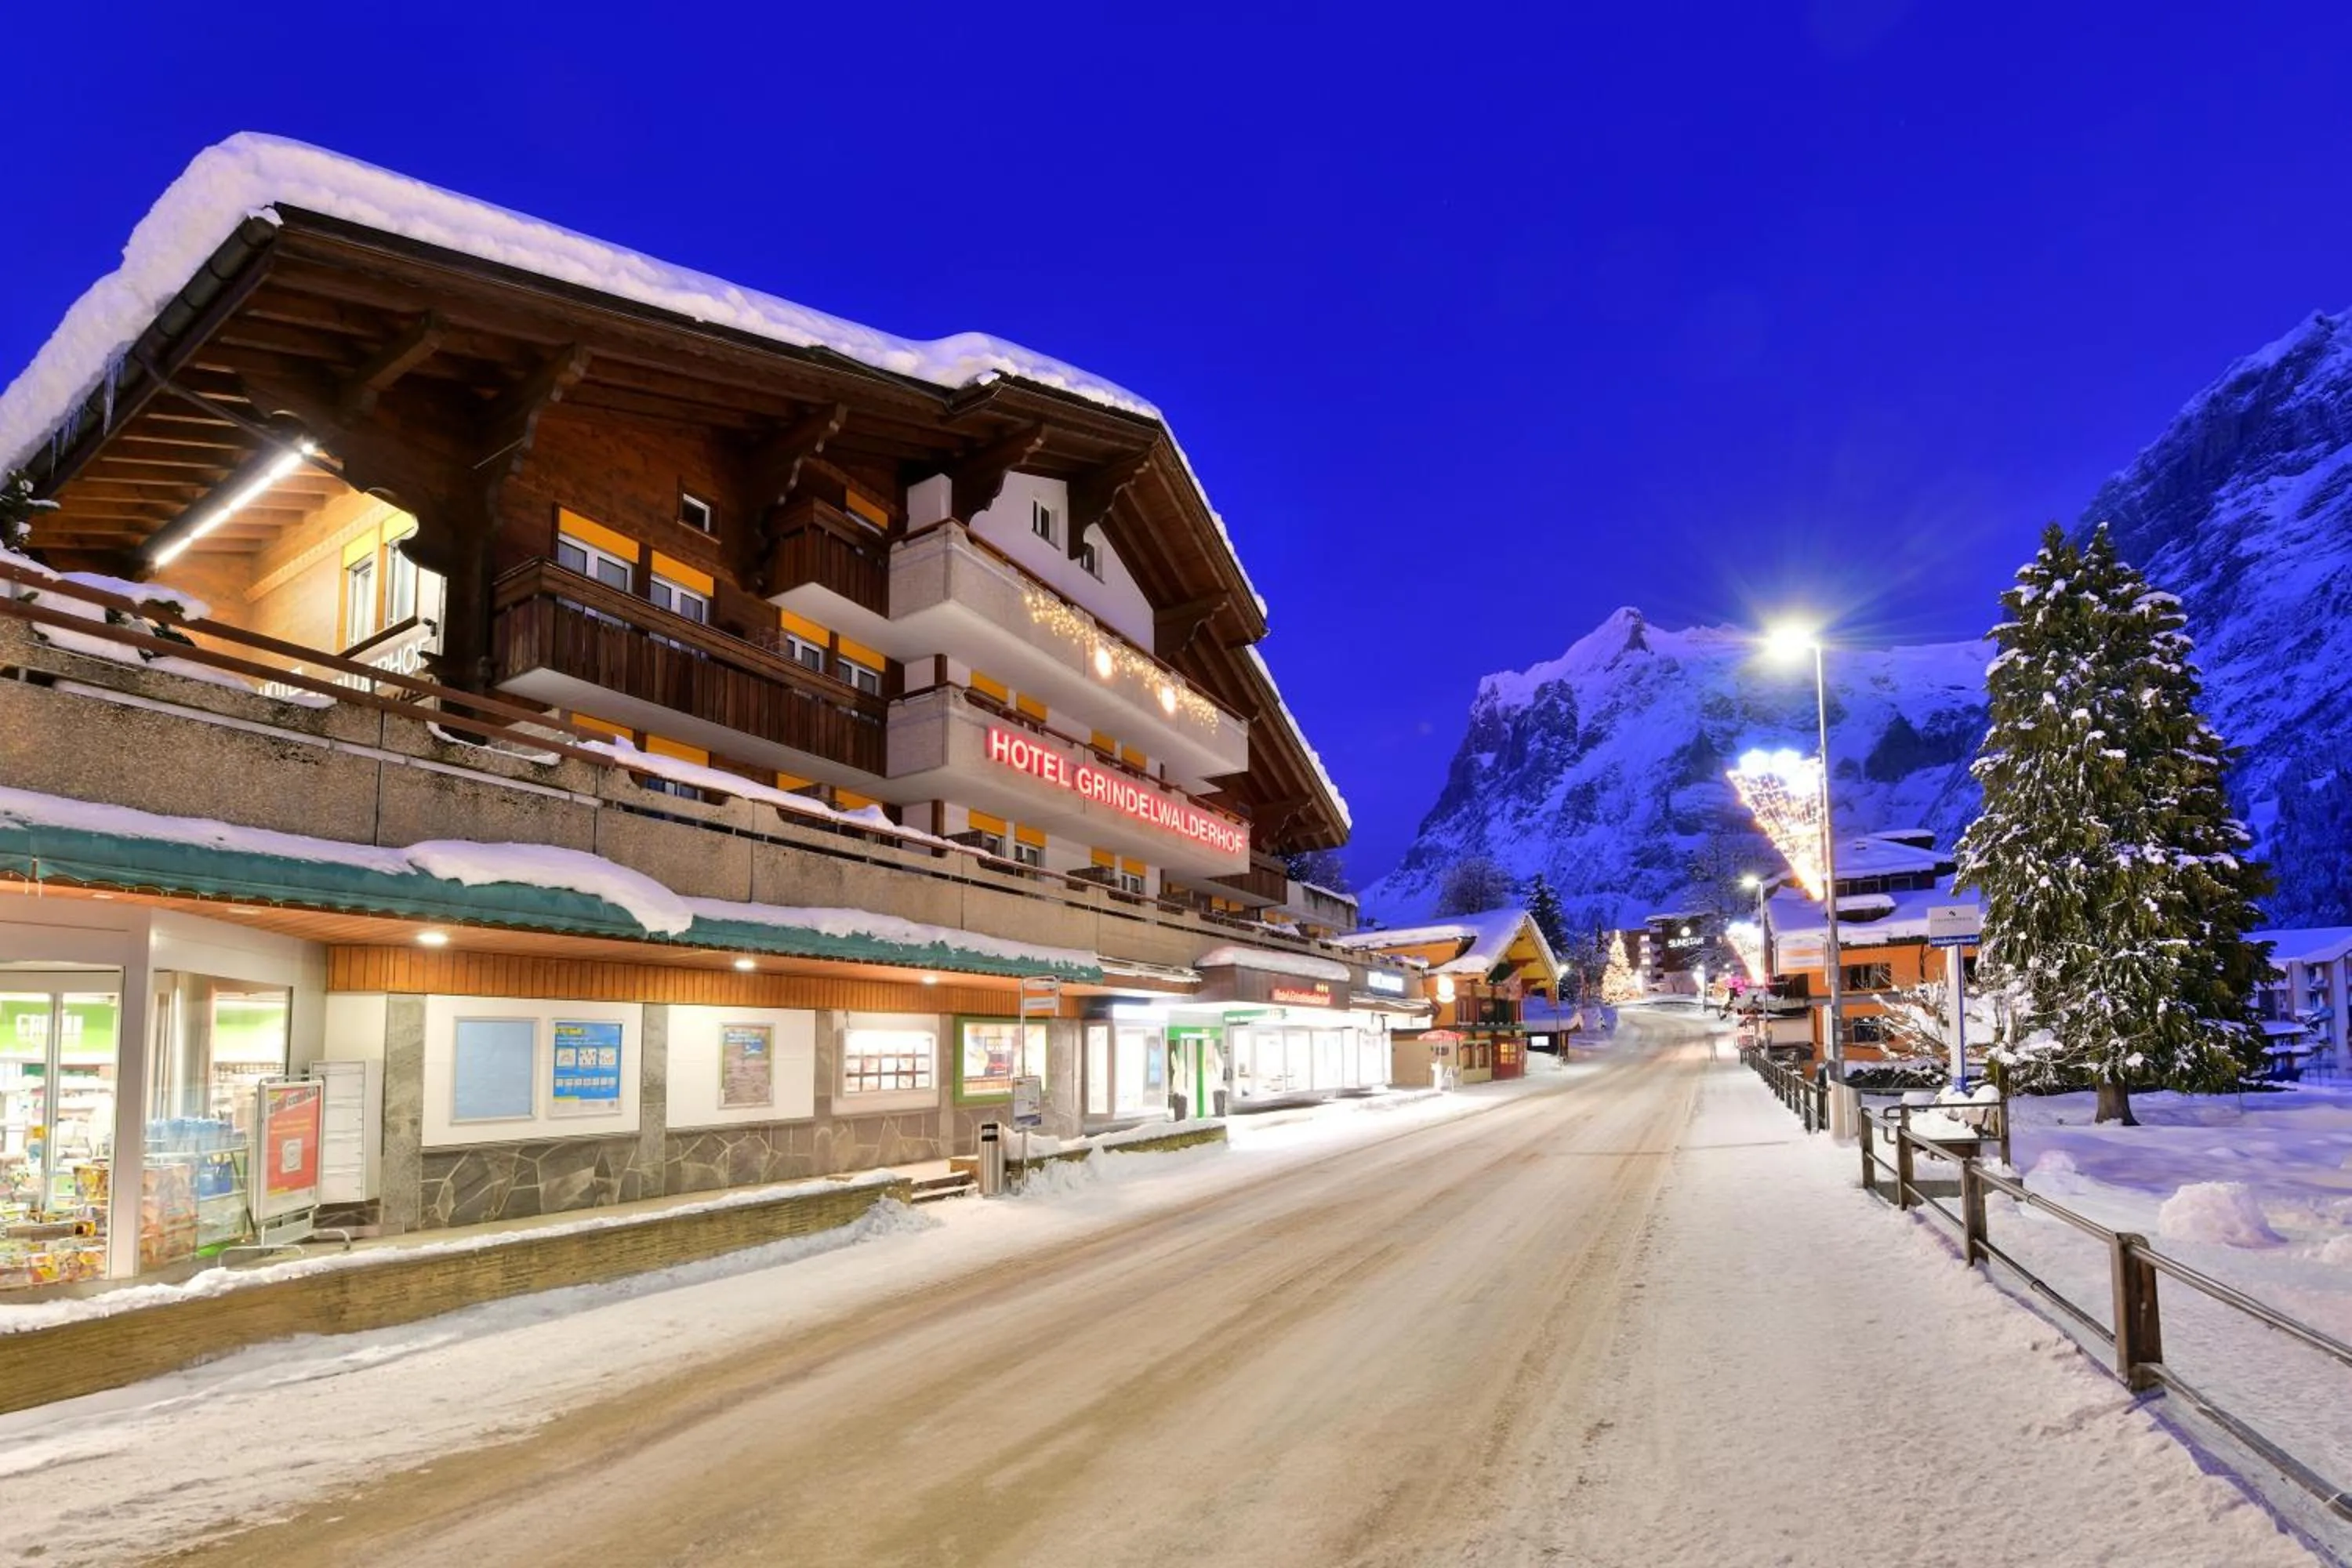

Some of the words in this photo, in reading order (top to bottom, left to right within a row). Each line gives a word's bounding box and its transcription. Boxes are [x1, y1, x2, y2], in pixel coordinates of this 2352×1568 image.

[990, 729, 1071, 788] HOTEL
[1077, 767, 1243, 854] GRINDELWALDERHOF
[1668, 937, 1704, 948] SUNSTAR
